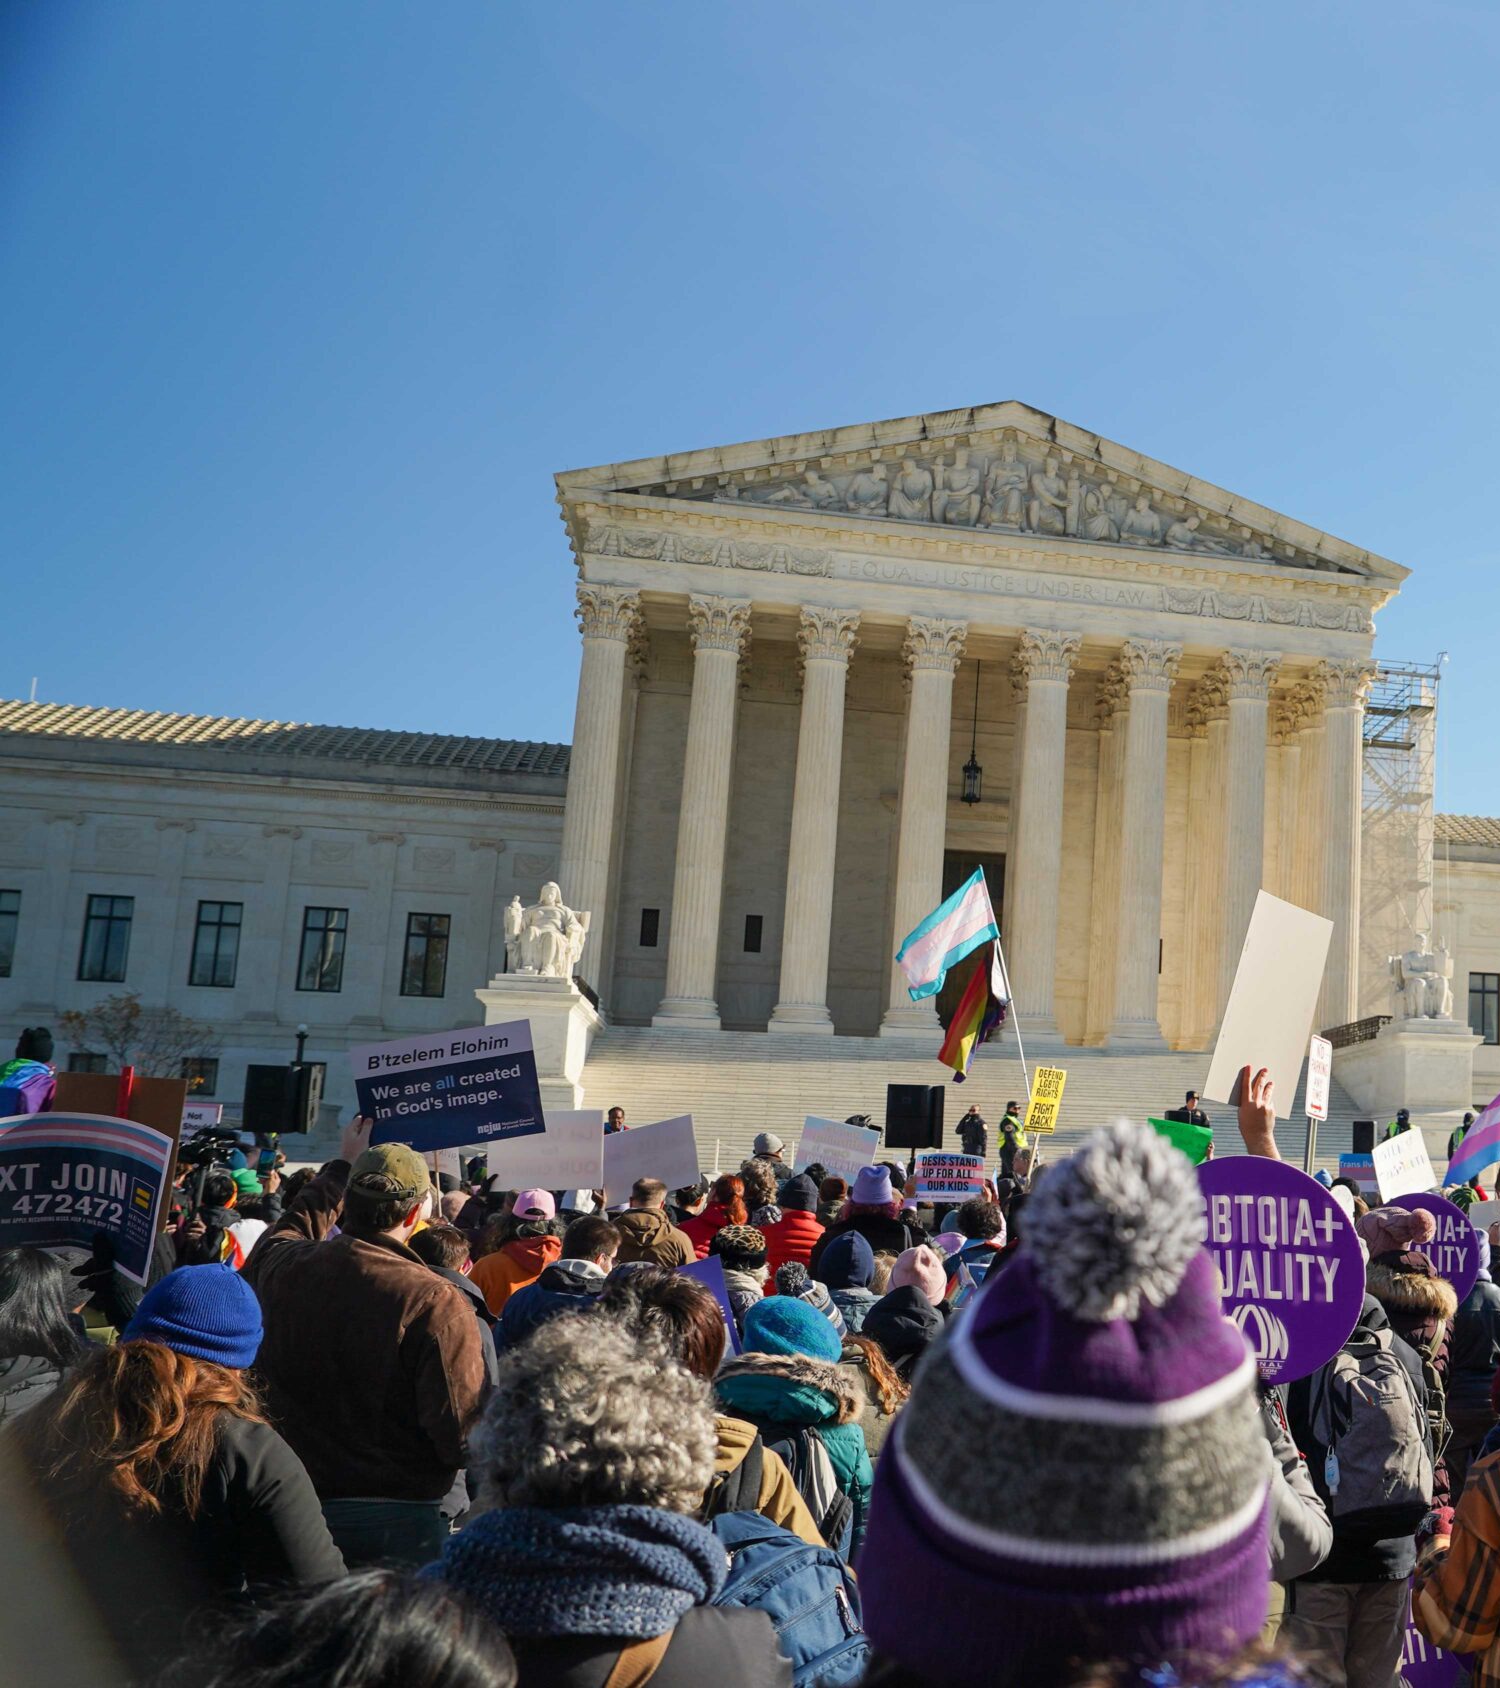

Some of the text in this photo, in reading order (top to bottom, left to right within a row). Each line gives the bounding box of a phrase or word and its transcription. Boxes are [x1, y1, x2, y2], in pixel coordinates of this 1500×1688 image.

[849, 560, 1145, 605] EQUAL JUSTICE UNDER LAW
[368, 1036, 509, 1070] B'tzelem Elohim
[1039, 1068, 1063, 1080] DEFEND
[371, 1064, 521, 1101] We are all created
[1040, 1079, 1059, 1090] LGBTQ
[1036, 1087, 1059, 1099] RIGHTS
[375, 1088, 503, 1119] in God's image.
[1033, 1102, 1055, 1115] FIGHT
[1029, 1114, 1053, 1127] BACK!
[477, 1121, 502, 1135] ncjw
[922, 1156, 978, 1168] DESIS STAND
[923, 1168, 934, 1178] UP
[936, 1168, 954, 1179] FOR
[51, 1162, 127, 1200] JOIN
[927, 1180, 969, 1191] OUR KIDS
[12, 1194, 124, 1225] 472472
